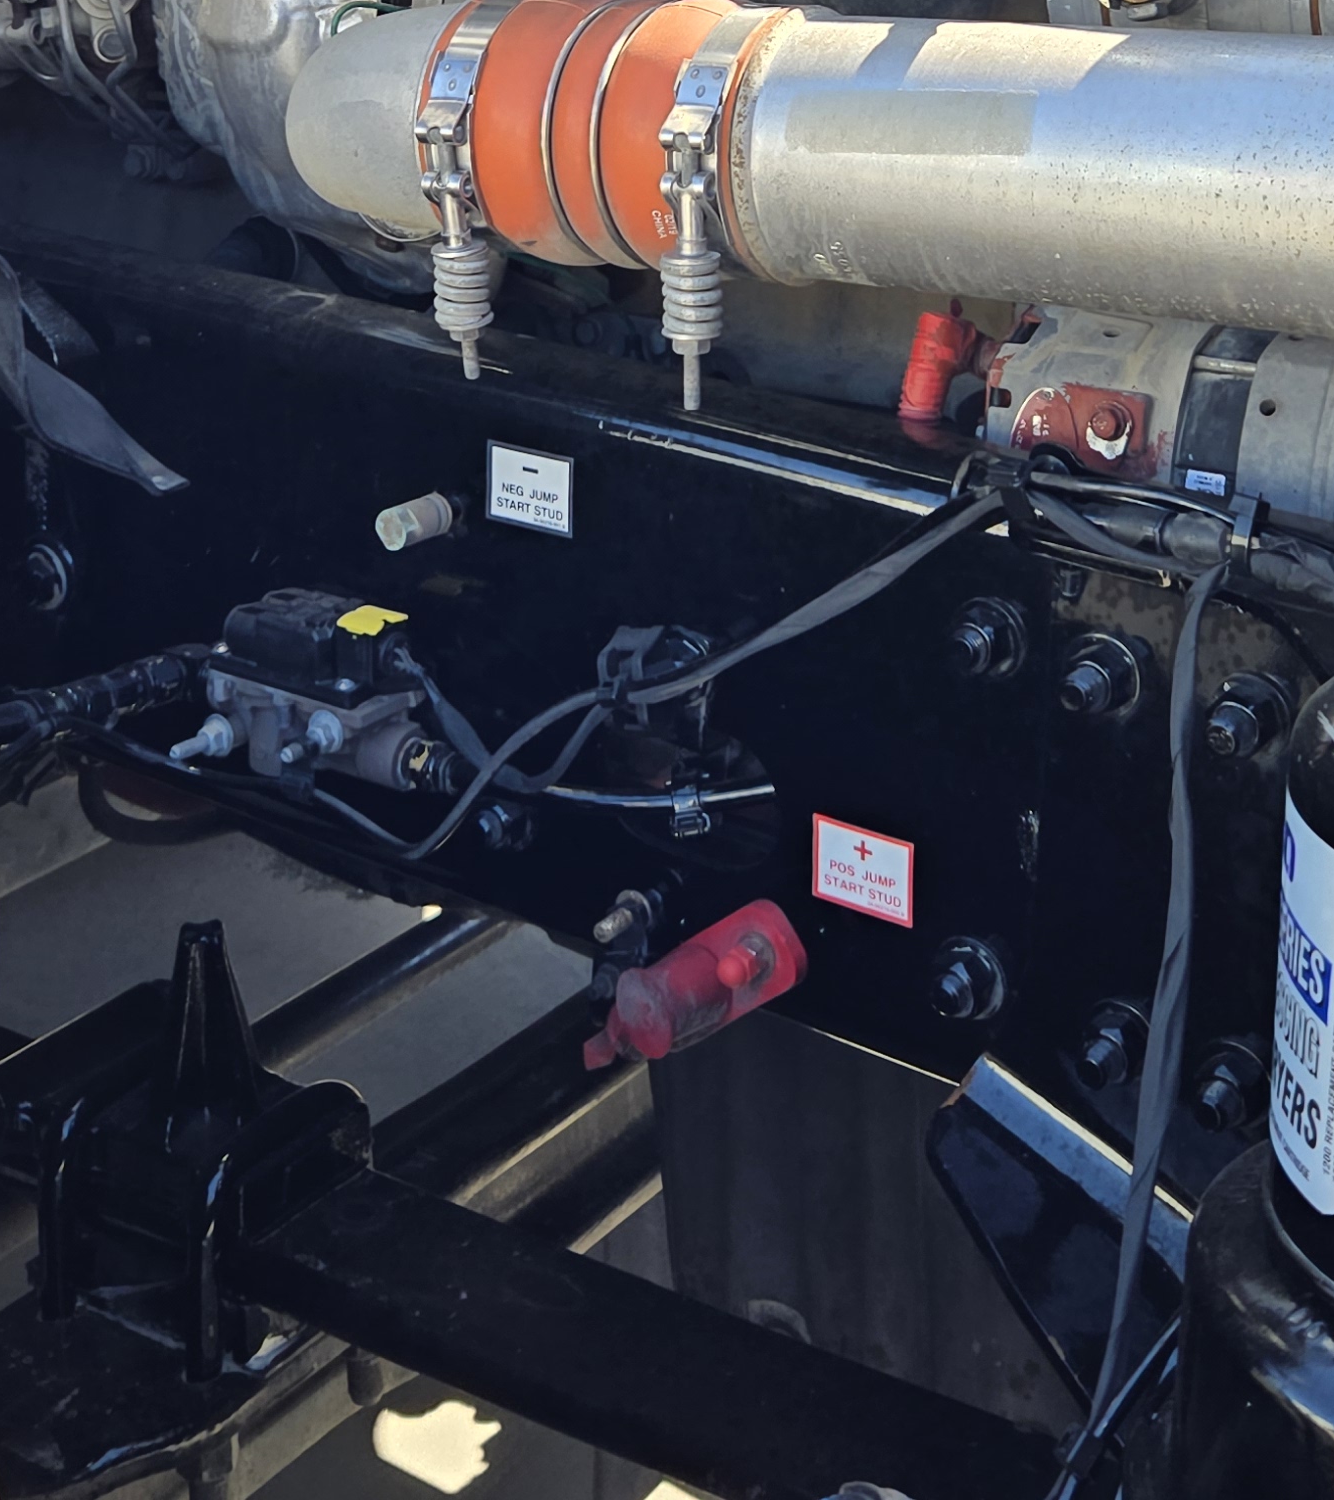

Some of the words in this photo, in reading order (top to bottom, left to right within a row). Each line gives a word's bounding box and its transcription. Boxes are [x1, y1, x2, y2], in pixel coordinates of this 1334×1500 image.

[651, 209, 667, 239] CHINA
[502, 482, 524, 497] NEG
[529, 489, 559, 504] JUMP
[497, 496, 531, 513] START
[534, 505, 563, 521] STUD
[829, 859, 855, 877] POS
[861, 870, 896, 889] JUMP
[824, 874, 865, 895] START
[868, 888, 902, 908] STUD
[1323, 1146, 1333, 1176] 1200
